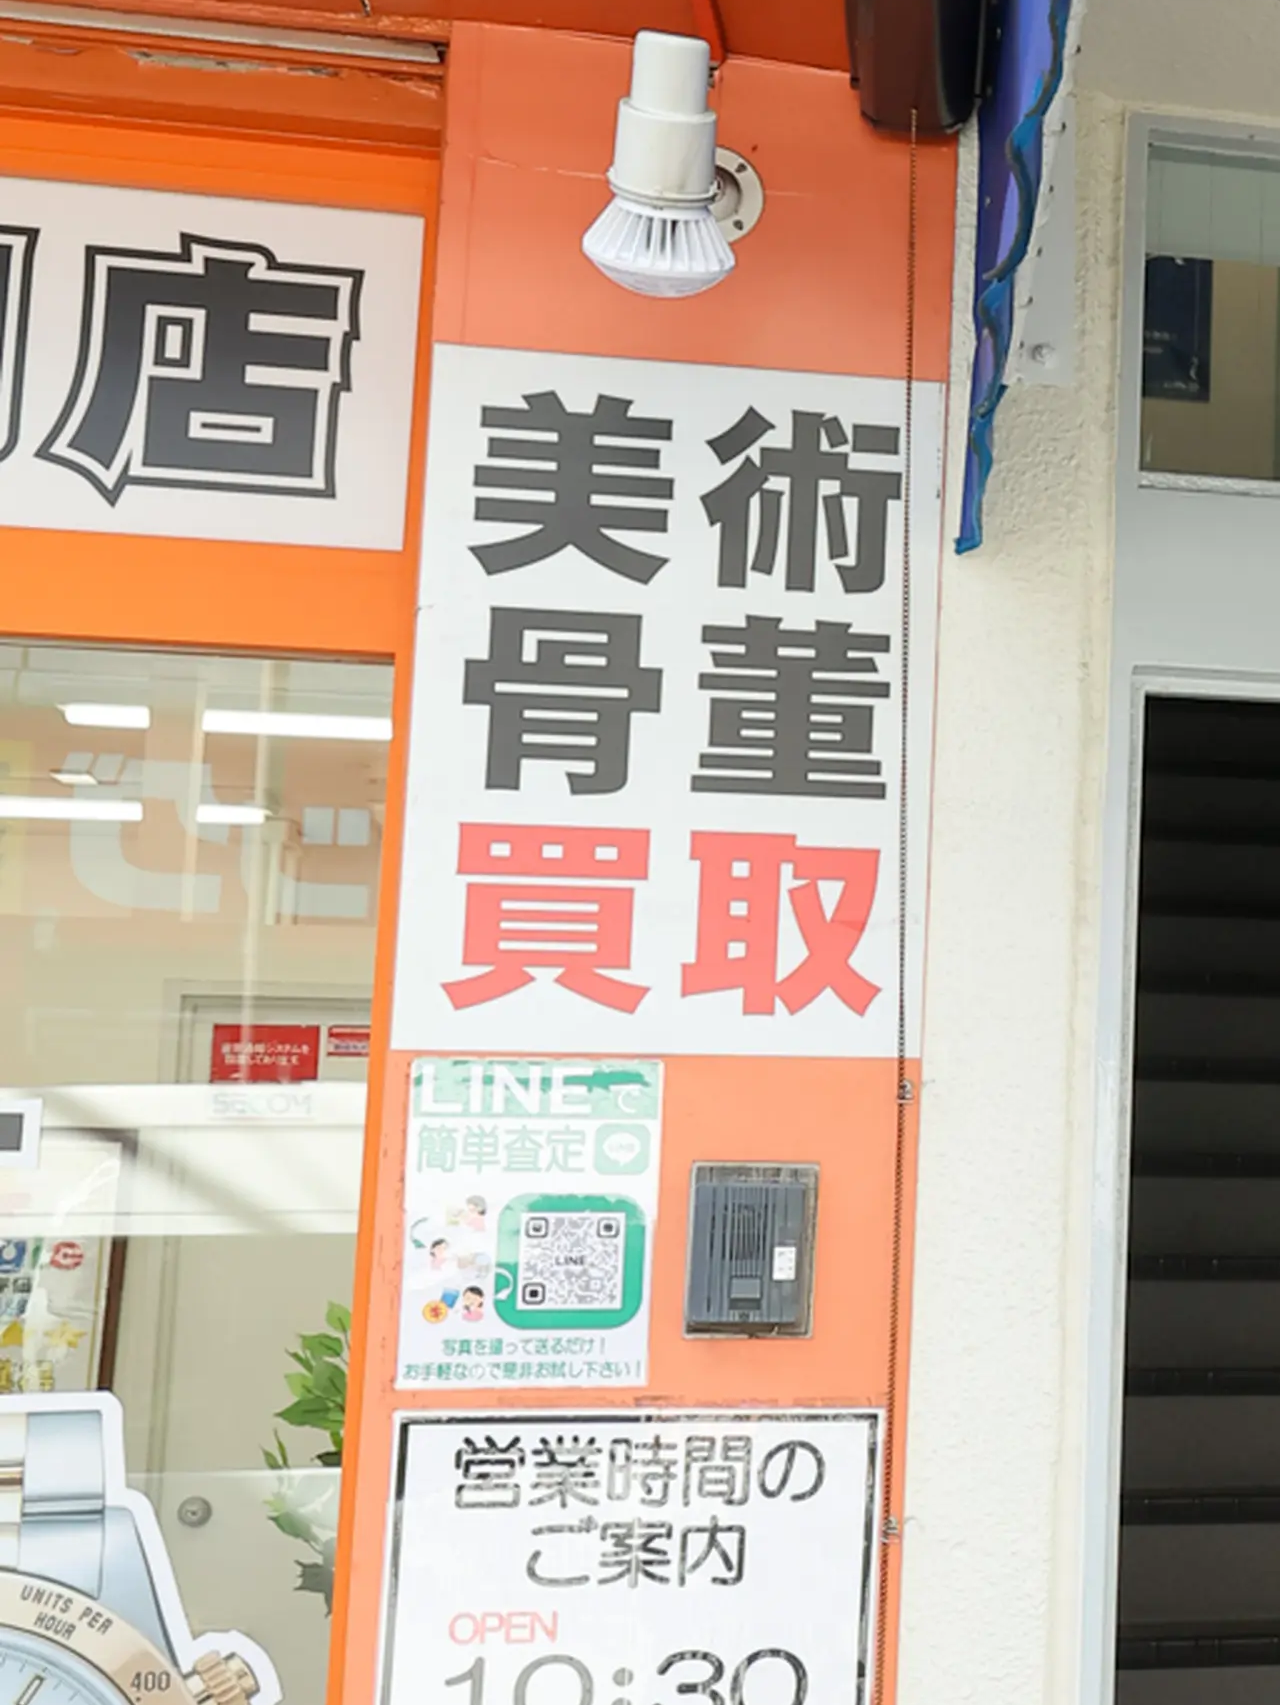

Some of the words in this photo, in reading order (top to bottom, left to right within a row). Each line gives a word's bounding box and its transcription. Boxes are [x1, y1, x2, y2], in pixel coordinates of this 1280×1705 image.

[0, 225, 366, 506] 店
[468, 390, 903, 594] 美術
[461, 605, 892, 800] 骨董
[440, 821, 883, 1016] 買取
[416, 1124, 587, 1174] 簡単査定
[455, 1435, 827, 1509] 営業時間の
[526, 1516, 746, 1588] ご案内
[20, 1585, 74, 1614] UNITS
[78, 1604, 114, 1636] PER
[34, 1611, 77, 1640] HOUR
[448, 1612, 558, 1645] OPEN
[130, 1671, 171, 1693] 400
